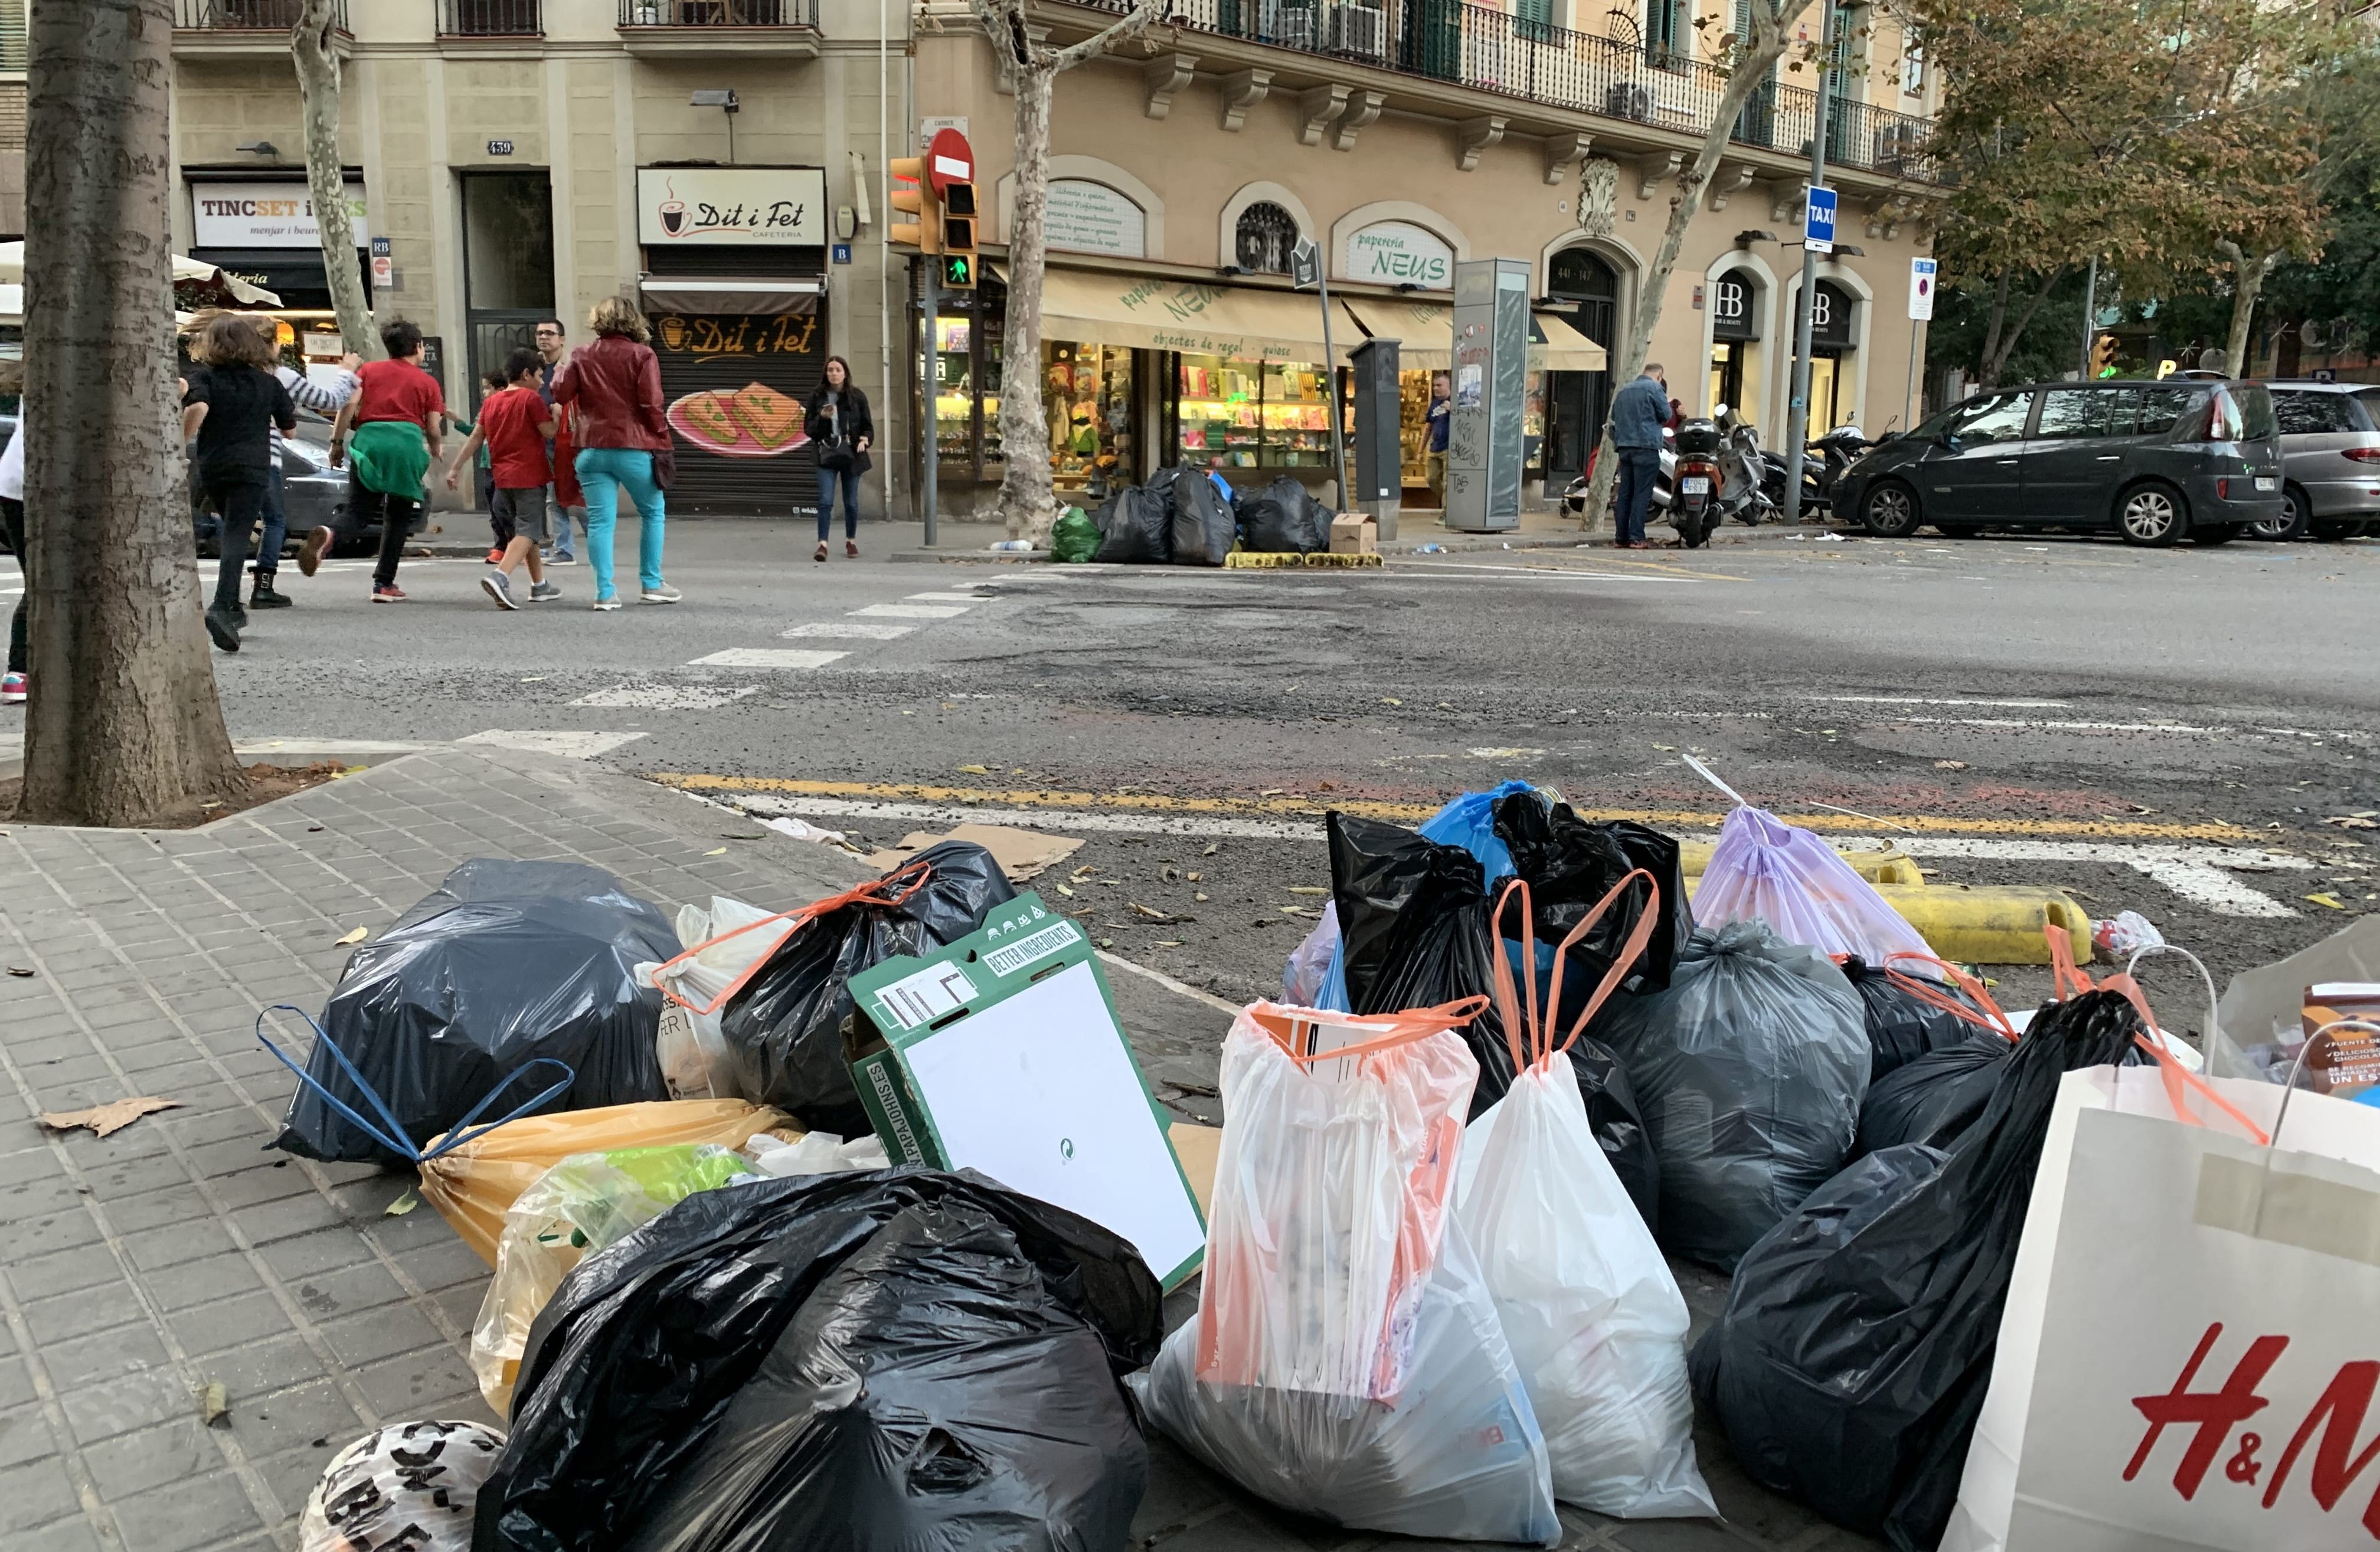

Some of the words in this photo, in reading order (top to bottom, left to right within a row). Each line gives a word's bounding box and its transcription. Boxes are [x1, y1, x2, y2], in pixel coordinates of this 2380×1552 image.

[491, 142, 511, 153] 439
[202, 200, 298, 217] TINCSET
[306, 200, 313, 217] i
[347, 201, 367, 217] ES
[695, 203, 743, 227] Dit
[748, 209, 759, 227] i
[766, 201, 803, 228] Fet
[1810, 205, 1835, 225] TAXI
[250, 226, 285, 237] menjar
[288, 226, 292, 235] i
[374, 242, 389, 253] RB
[1358, 234, 1404, 251] papereria
[838, 248, 846, 259] B
[1371, 250, 1445, 281] NEUS
[1118, 280, 1167, 312] paperer
[691, 316, 751, 352] Dit
[756, 330, 768, 352] i
[773, 315, 817, 353] Fet
[1153, 330, 1196, 349] objectes
[1200, 337, 1212, 350] de
[1217, 338, 1243, 356] regal
[1262, 343, 1291, 358] quiosc
[2156, 359, 2177, 381] P
[987, 947, 1026, 974] BETTER
[1017, 925, 1077, 960] INGREDIENTS.
[2330, 1076, 2352, 1084] UN
[2358, 1073, 2380, 1082] ES
[2123, 1322, 2380, 1540] H&M
